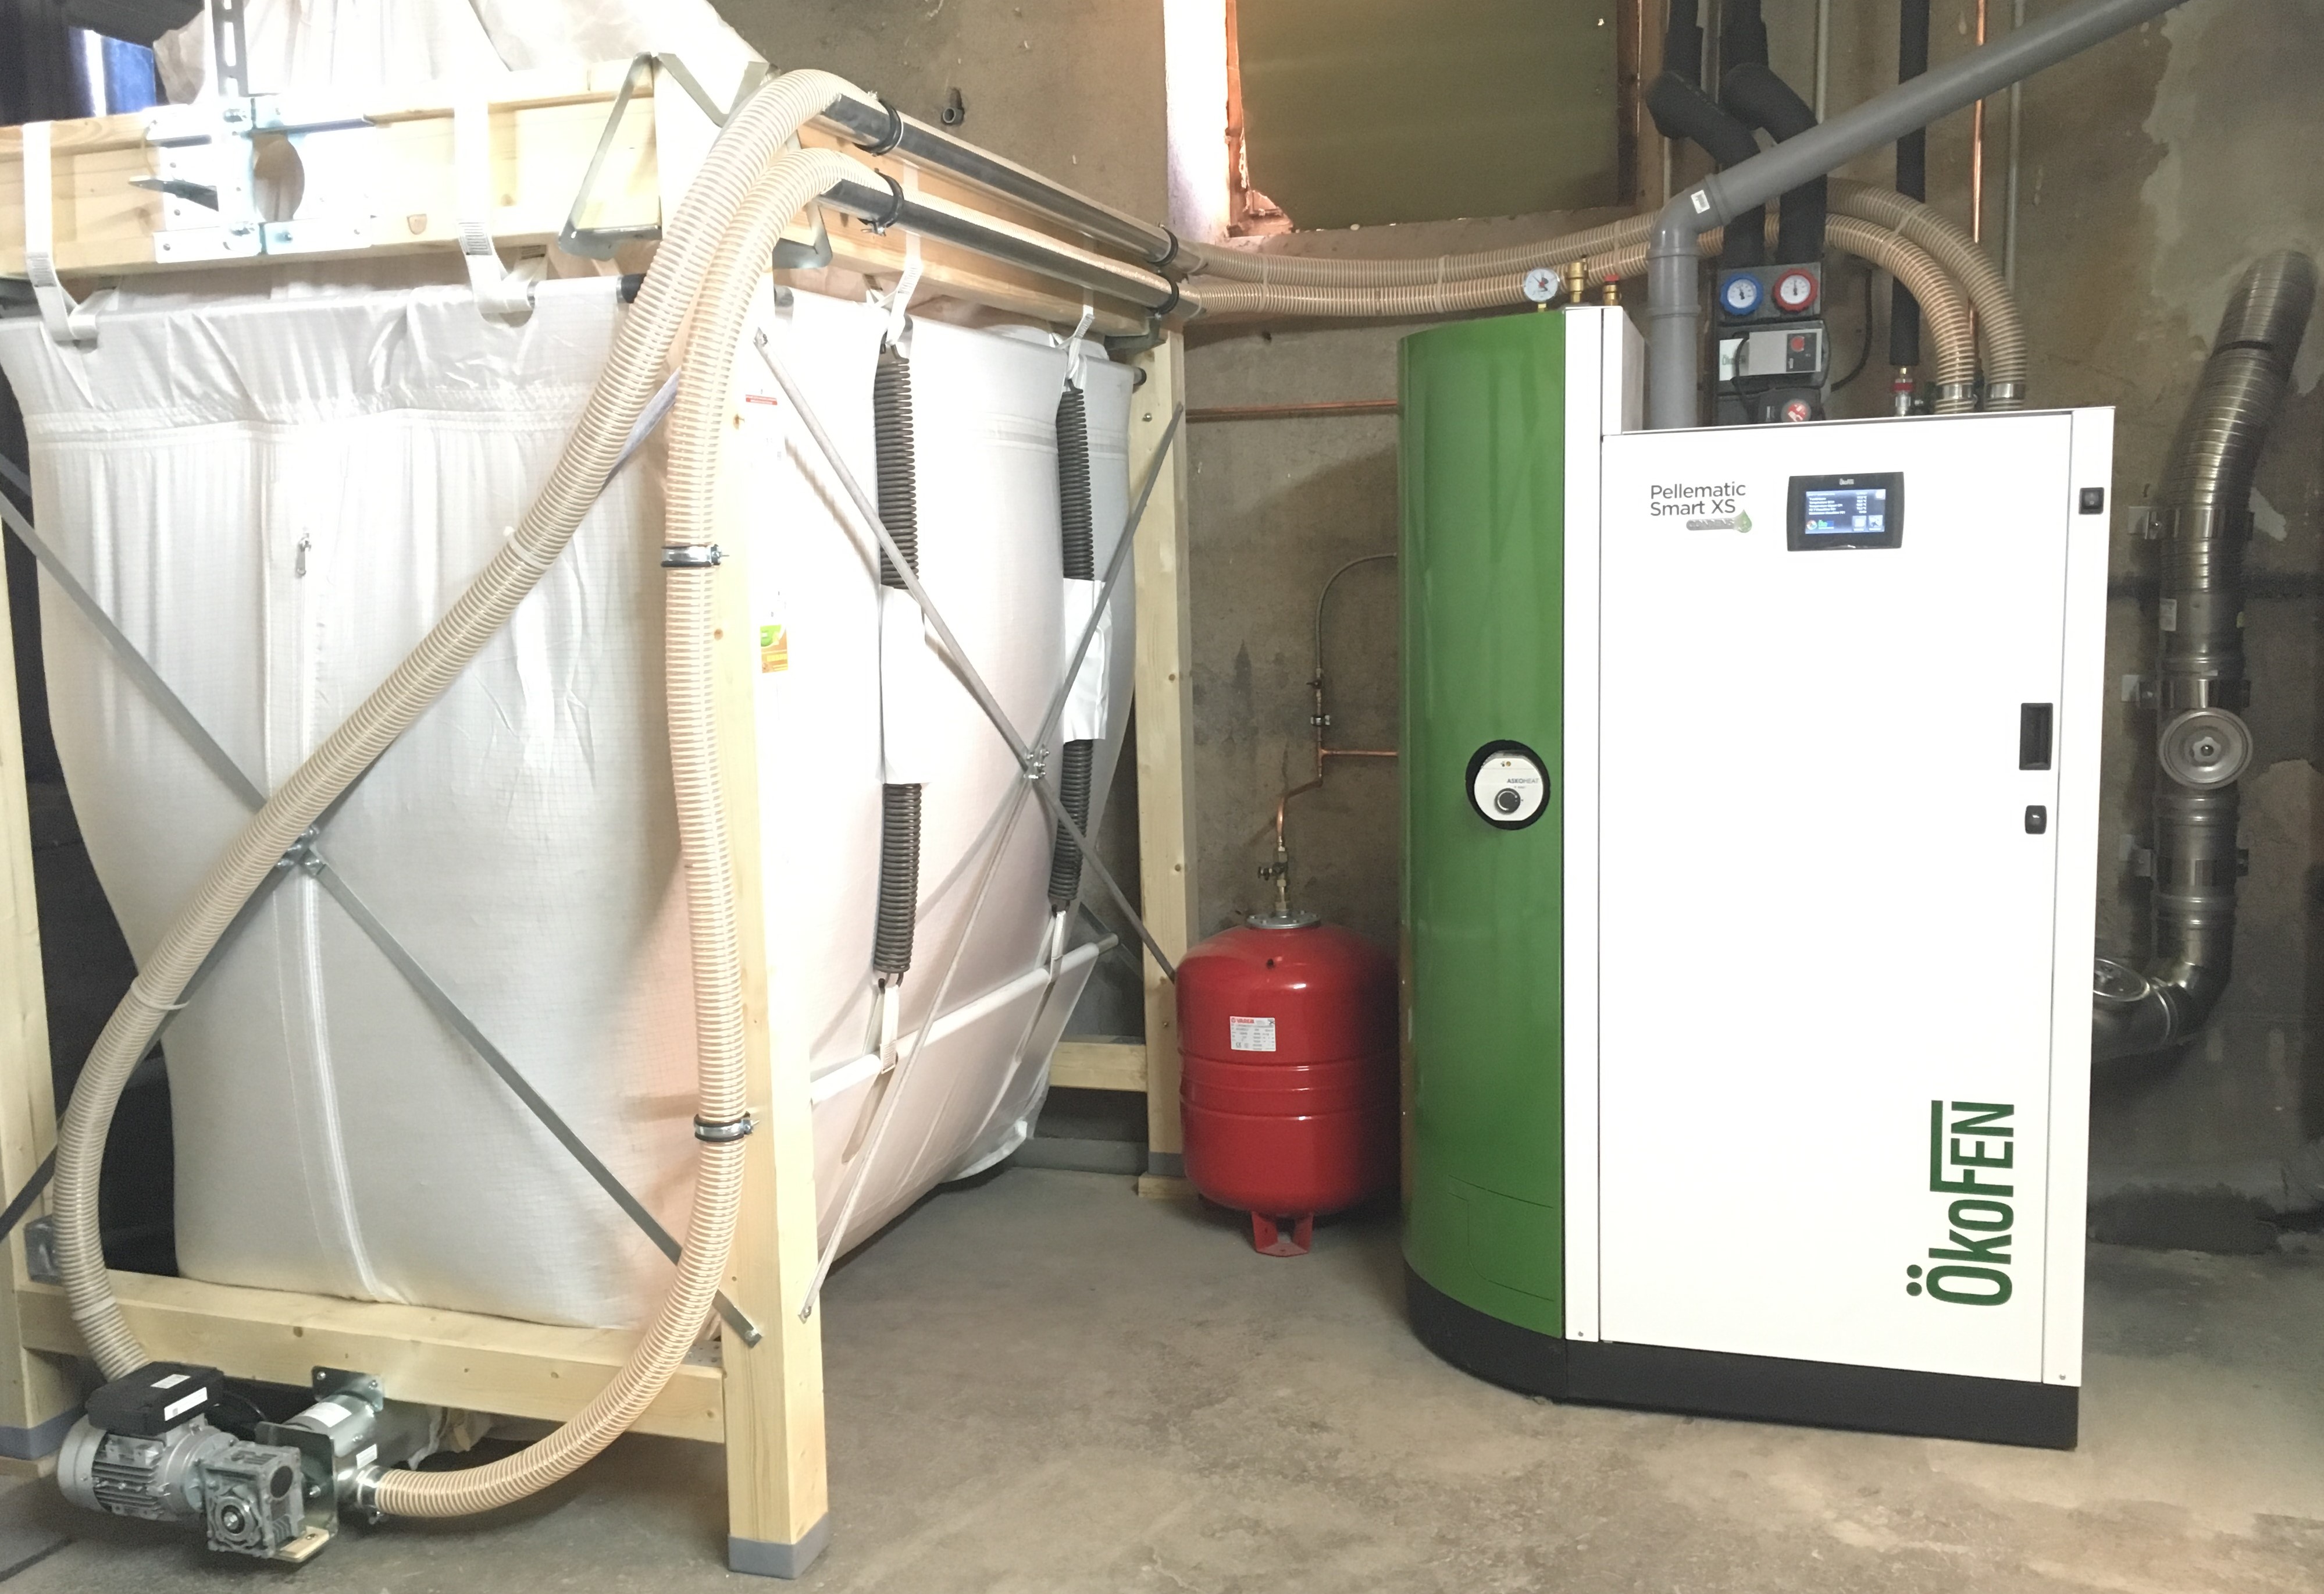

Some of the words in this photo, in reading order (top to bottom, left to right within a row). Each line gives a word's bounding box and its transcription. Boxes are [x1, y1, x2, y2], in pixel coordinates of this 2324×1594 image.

[1651, 481, 1746, 499] Pellematic
[1651, 501, 1705, 516] Smart
[1712, 499, 1735, 514] XS
